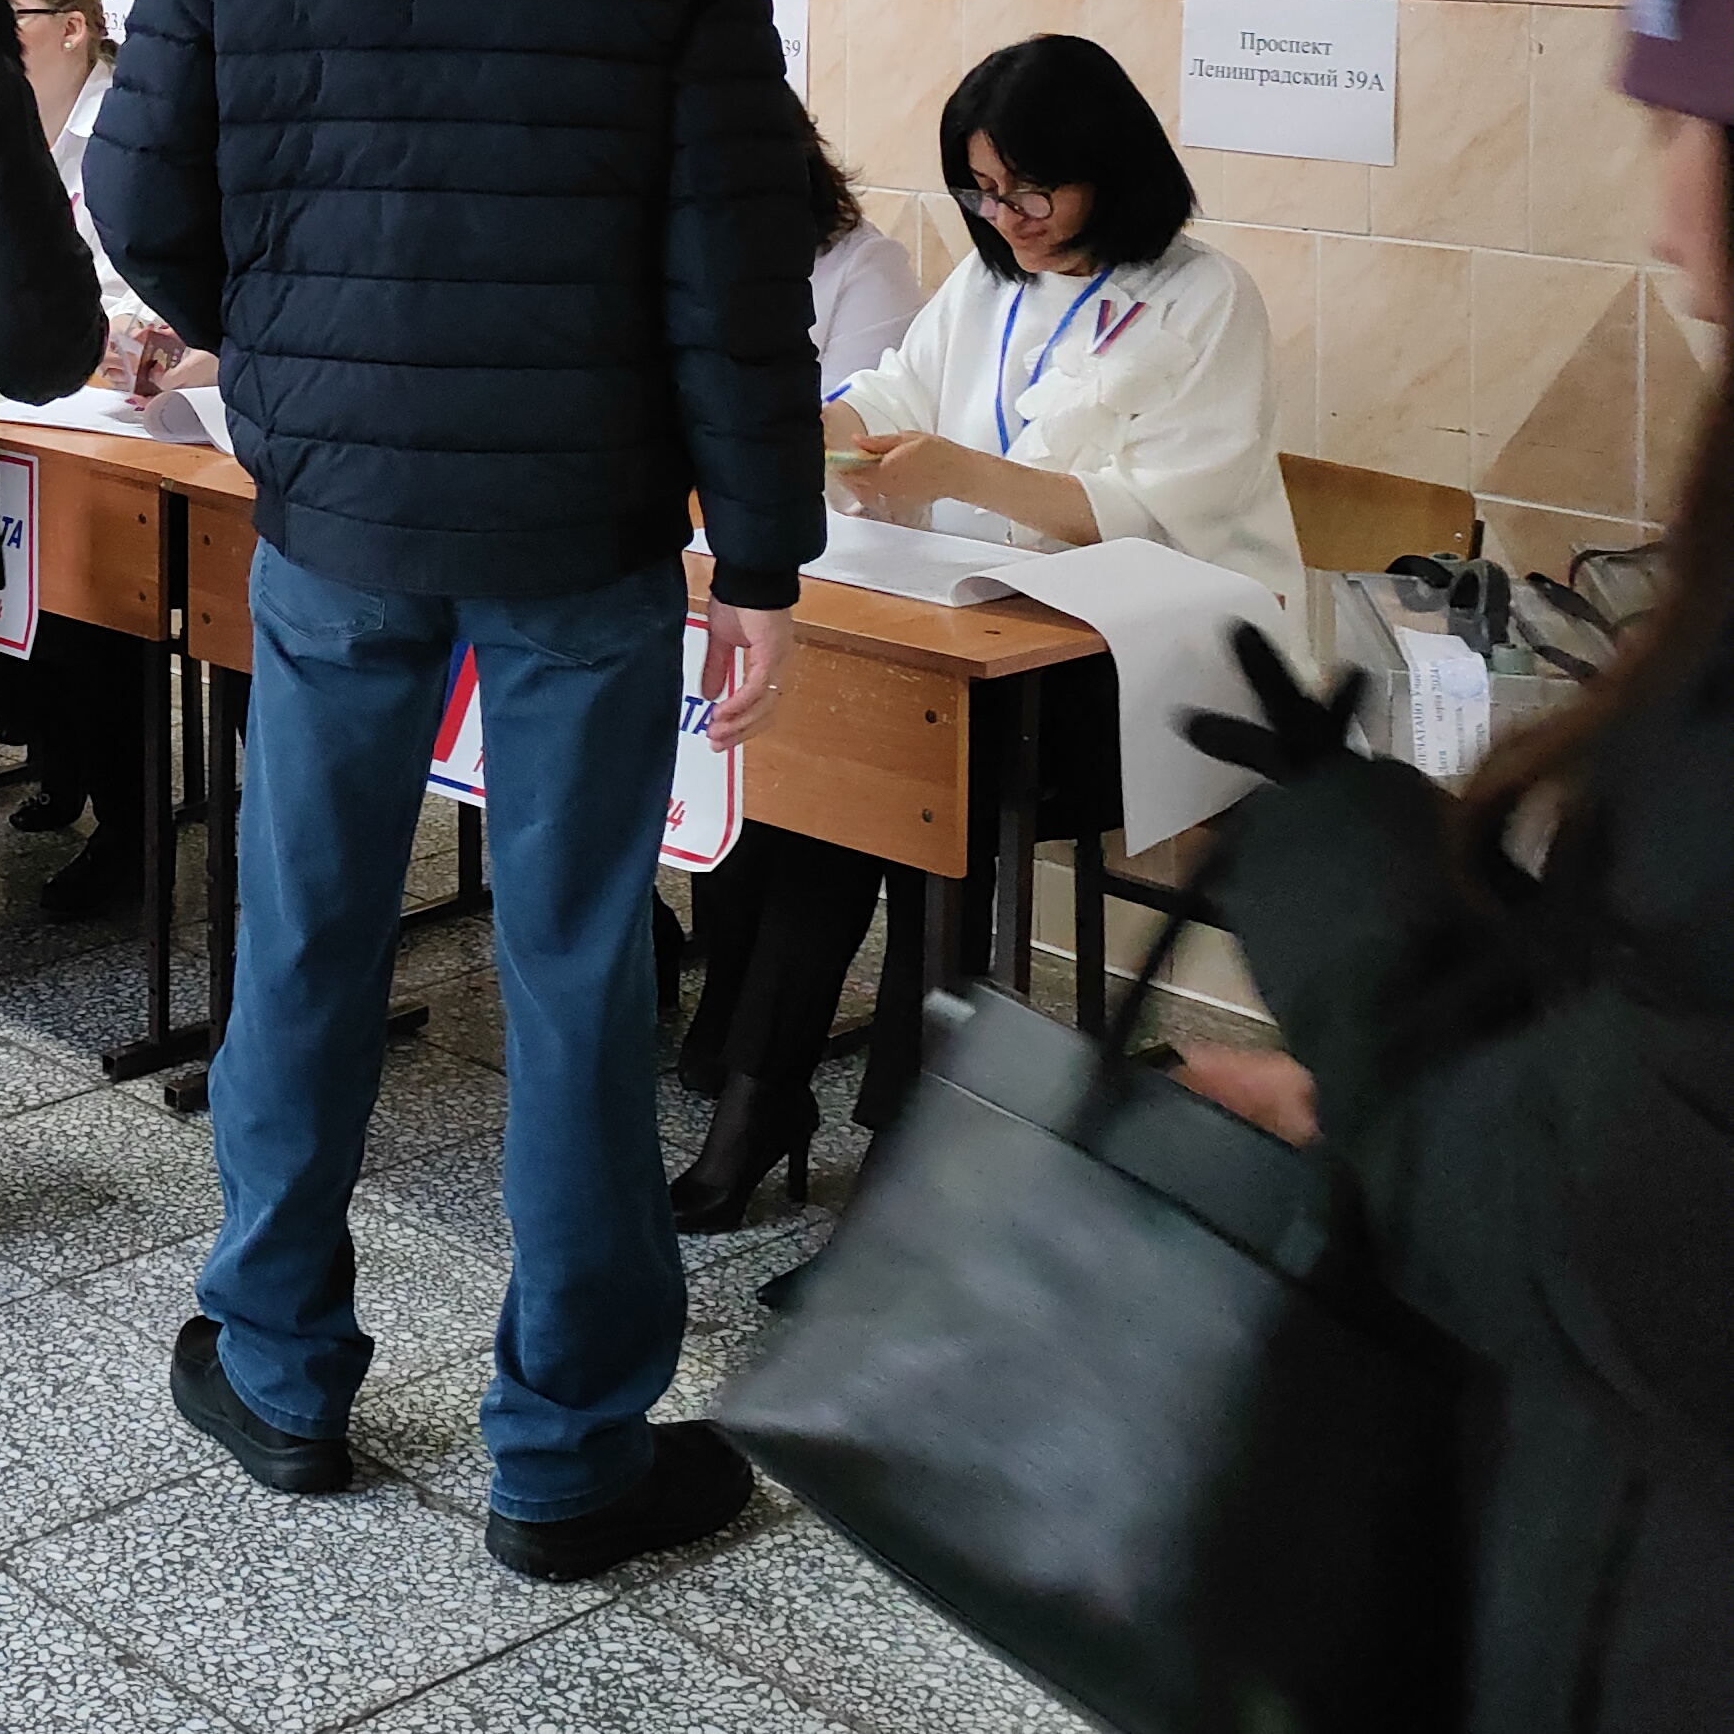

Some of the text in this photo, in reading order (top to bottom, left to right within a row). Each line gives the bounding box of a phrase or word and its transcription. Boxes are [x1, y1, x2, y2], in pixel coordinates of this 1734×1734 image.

[782, 39, 801, 58] 39
[1239, 31, 1333, 56] Проспект
[1188, 58, 1385, 91] Ленинградский 39А
